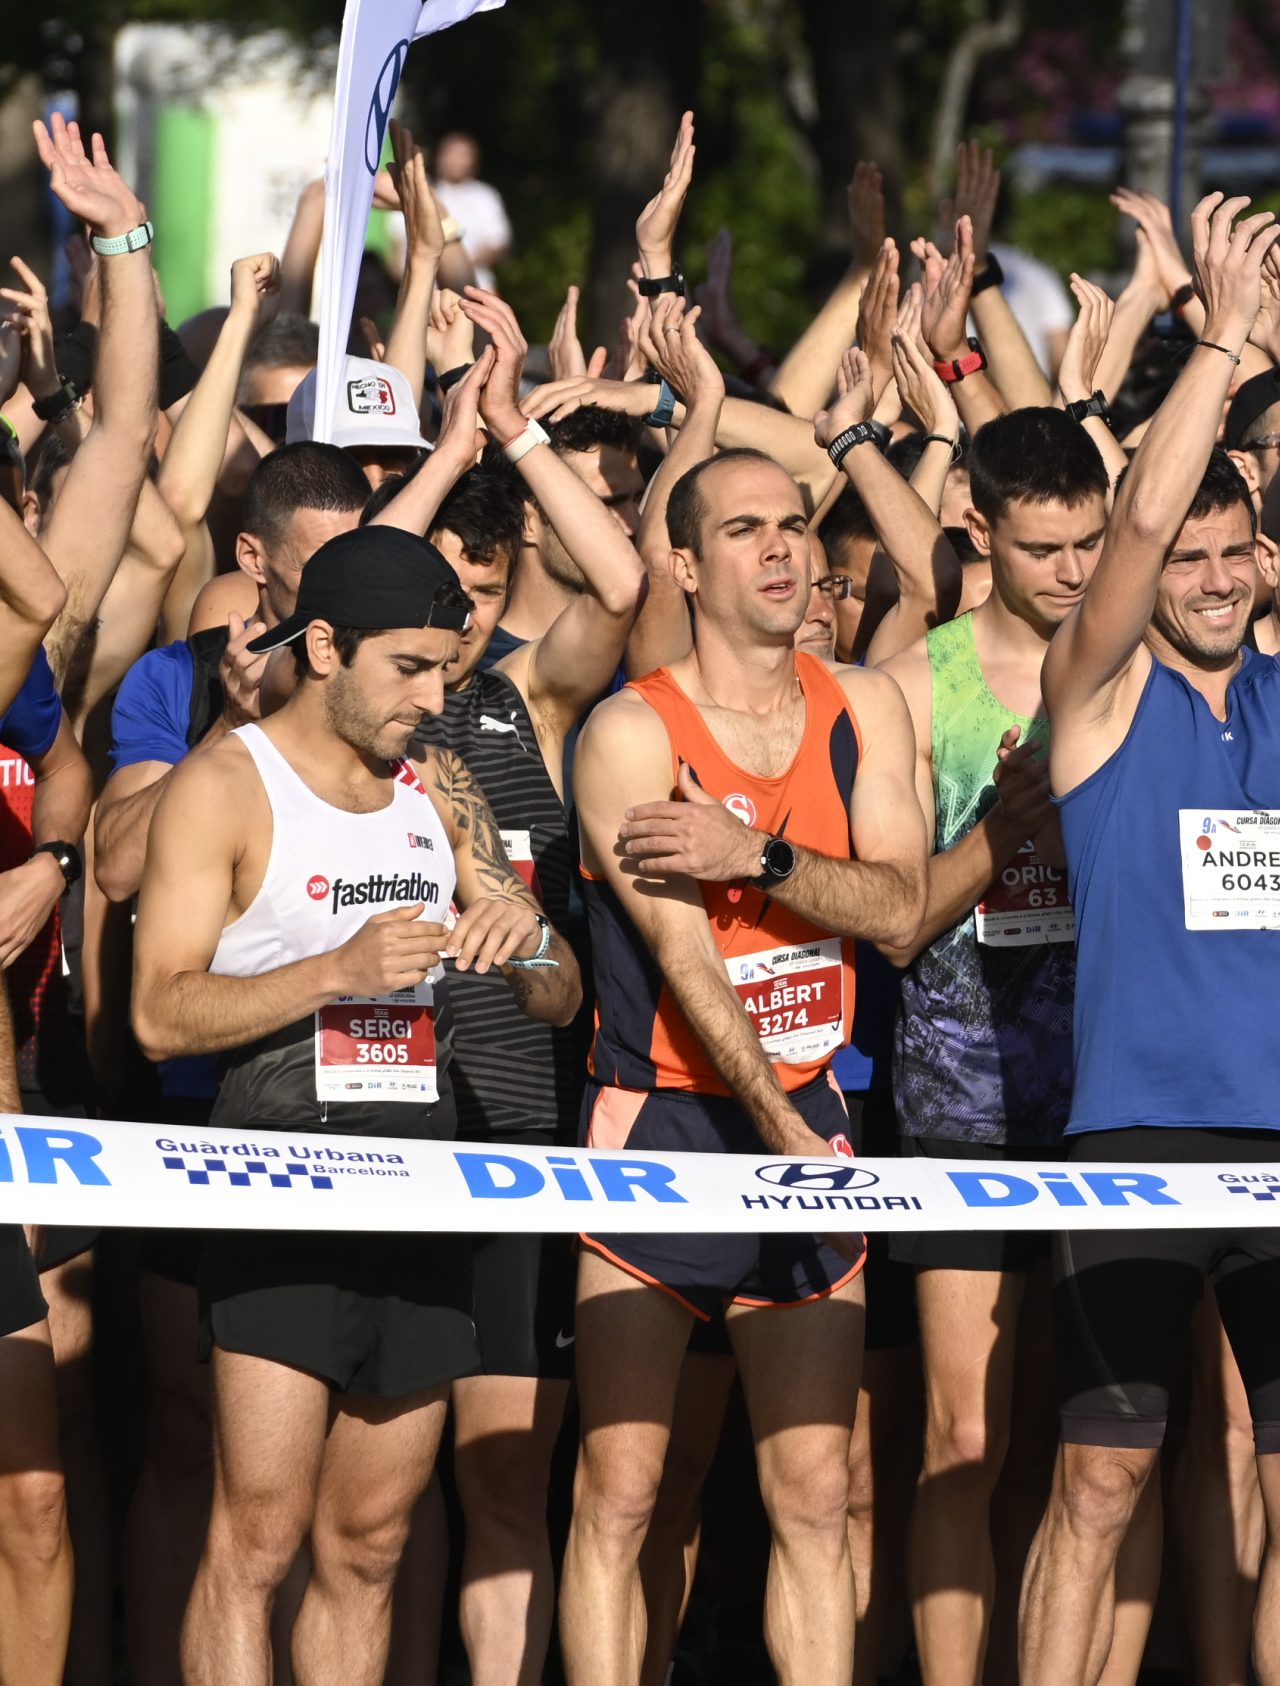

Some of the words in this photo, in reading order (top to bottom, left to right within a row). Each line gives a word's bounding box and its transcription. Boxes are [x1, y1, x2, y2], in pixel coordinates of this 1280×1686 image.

[1236, 816, 1258, 826] CURSA
[332, 872, 439, 913] fasttriatlon
[1222, 873, 1280, 891] 6043
[1028, 888, 1058, 907] 63
[744, 981, 826, 1015] ALBERT
[349, 1018, 413, 1039] SERGI
[758, 1007, 809, 1036] 3274
[355, 1043, 409, 1064] 3605
[155, 1138, 280, 1158] Guàrdia
[287, 1145, 405, 1164] Urbana
[313, 1164, 411, 1178] Barcelona
[452, 1152, 690, 1203] DiR
[945, 1171, 1183, 1207] DiR
[741, 1194, 923, 1210] HYUNDAI
